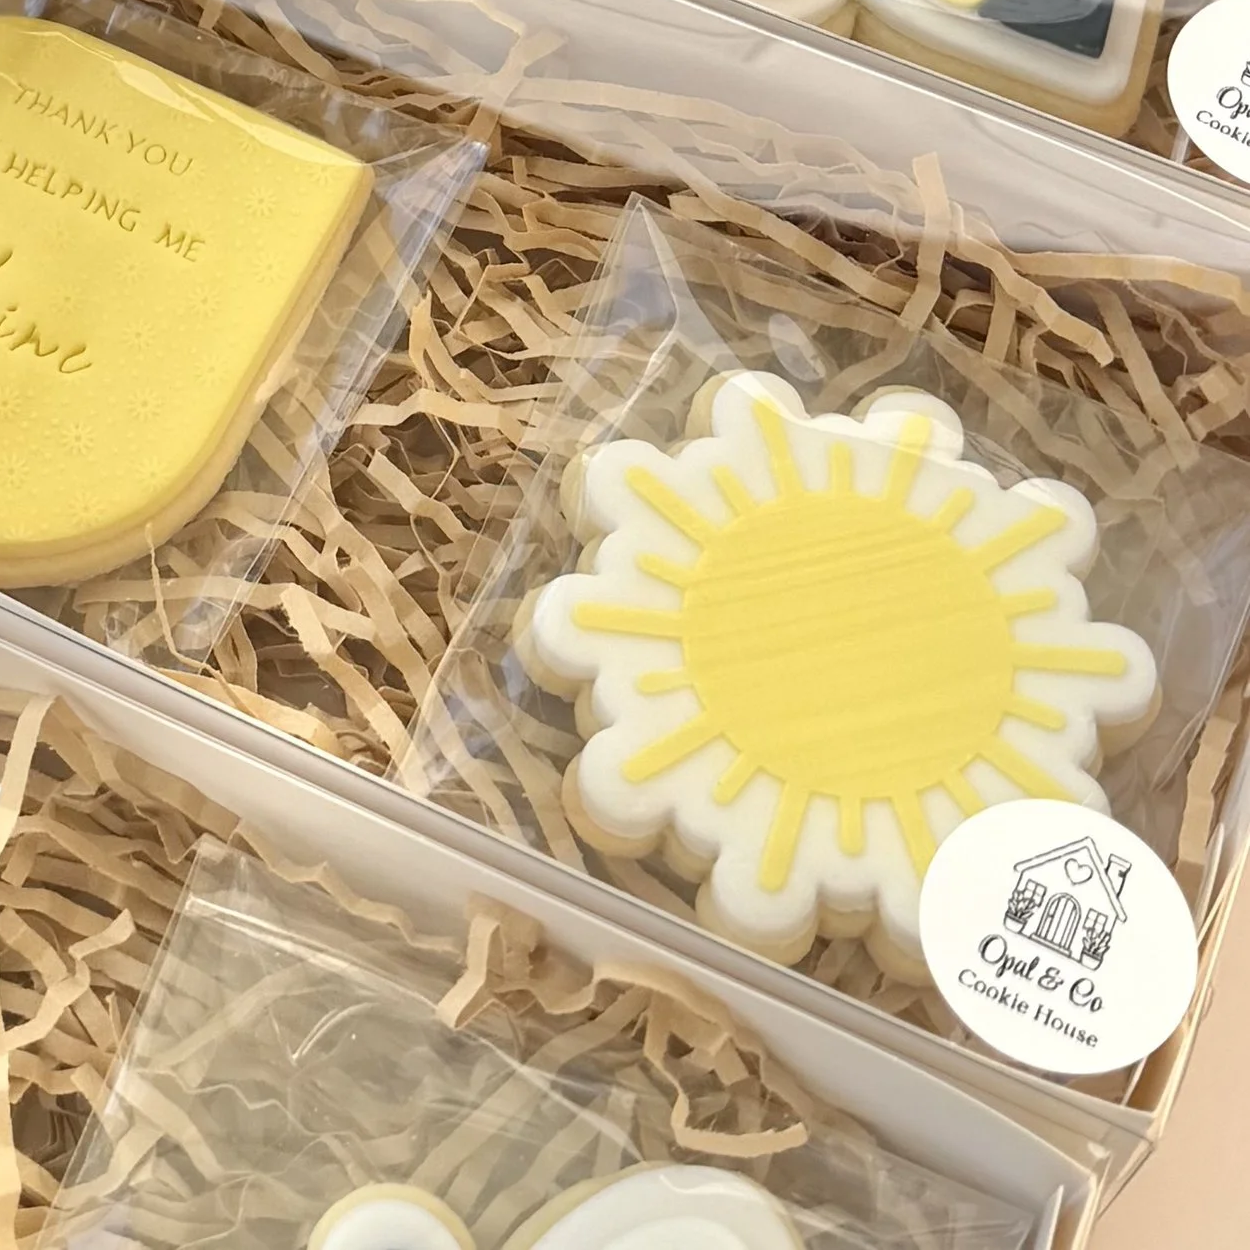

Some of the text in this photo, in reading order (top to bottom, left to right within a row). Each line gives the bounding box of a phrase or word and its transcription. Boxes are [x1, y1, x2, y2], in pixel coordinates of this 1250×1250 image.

[2, 152, 142, 233] HELPING
[153, 222, 207, 263] ME
[957, 968, 1099, 1048] Cookie House
[978, 933, 1104, 1013] Opal & Co
